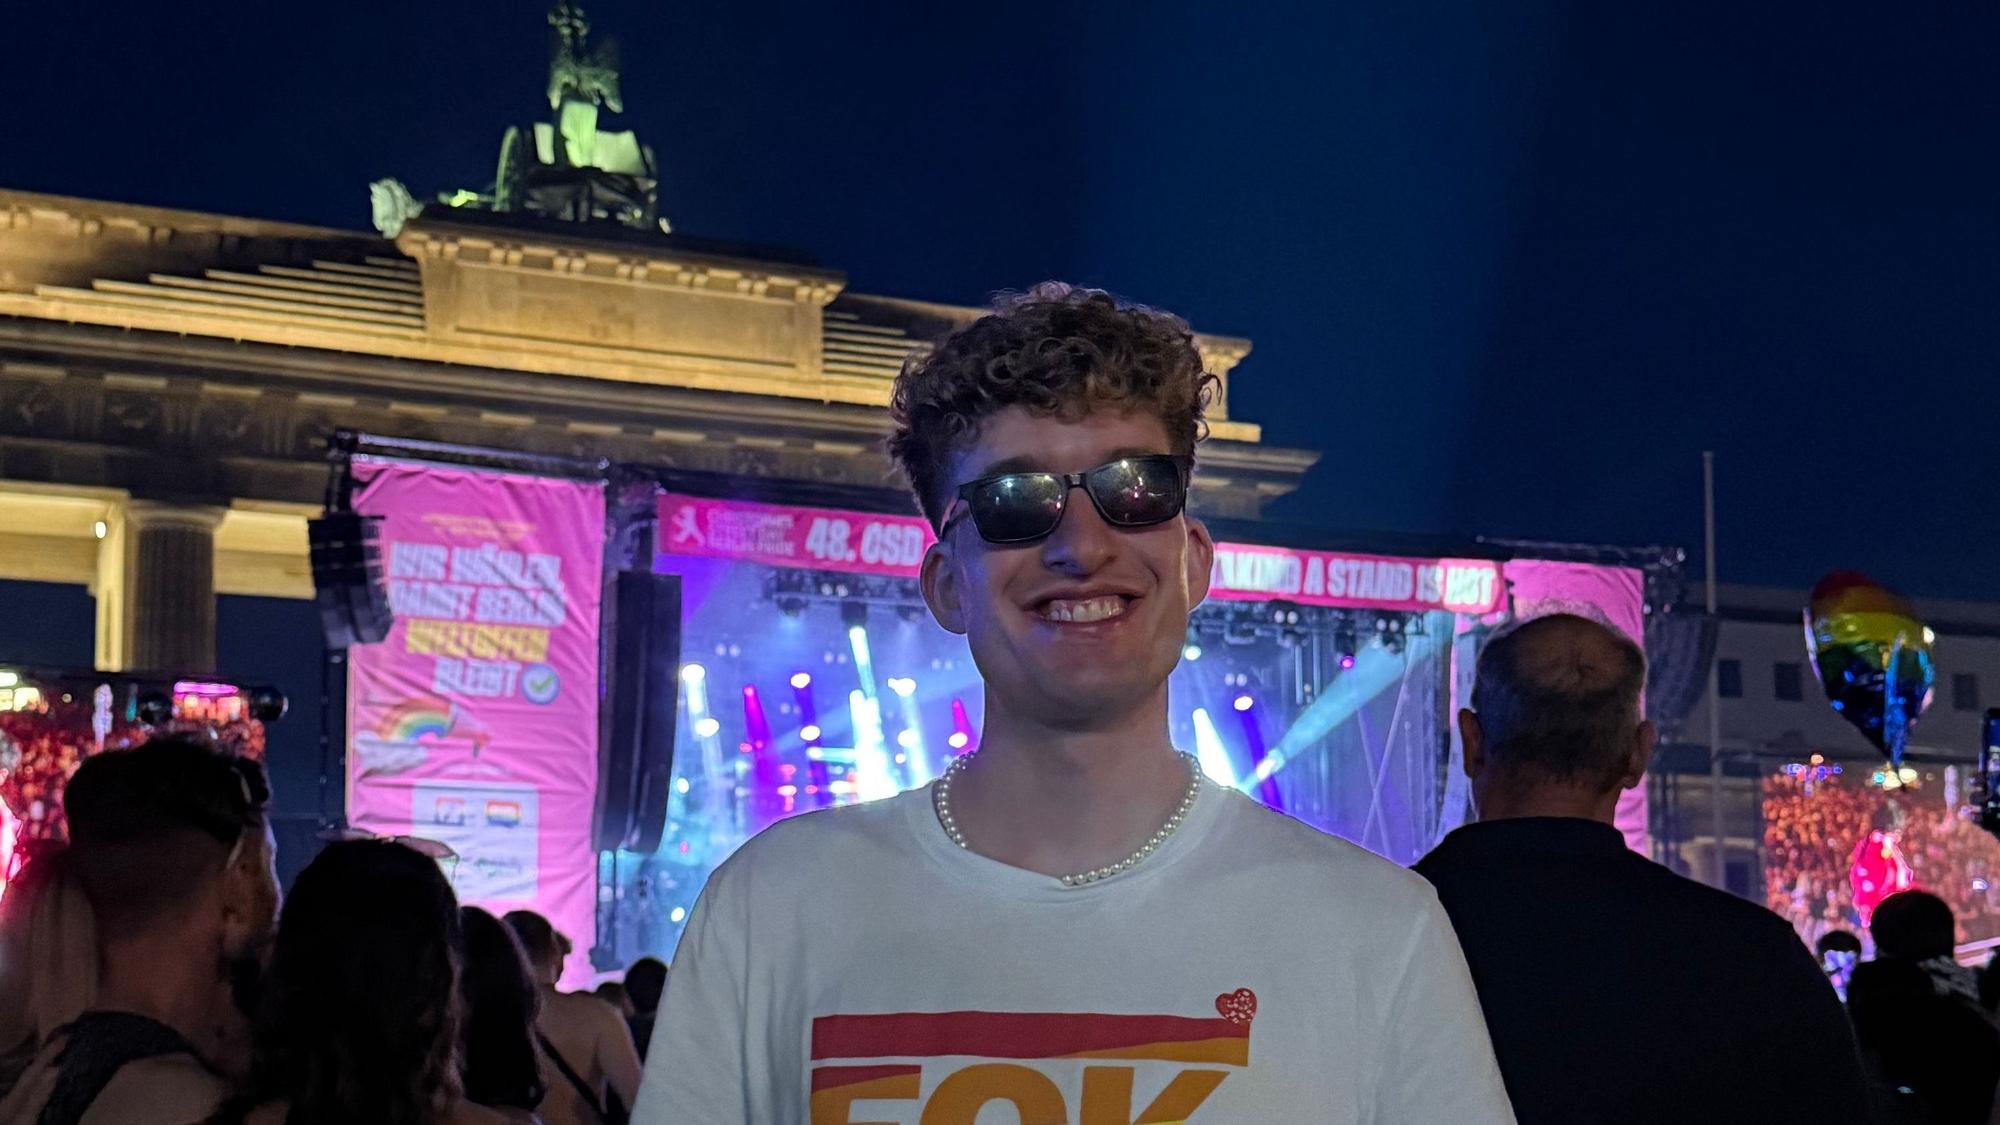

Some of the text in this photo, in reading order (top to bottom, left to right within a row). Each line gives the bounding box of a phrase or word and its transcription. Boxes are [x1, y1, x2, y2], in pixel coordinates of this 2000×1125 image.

[805, 517, 856, 562] 48.
[861, 522, 924, 566] CSD
[1210, 551, 1301, 594] AKING
[1303, 556, 1325, 595] A
[1327, 558, 1413, 601] STAND
[1416, 564, 1443, 604] IS
[432, 656, 522, 697] BLEIBT
